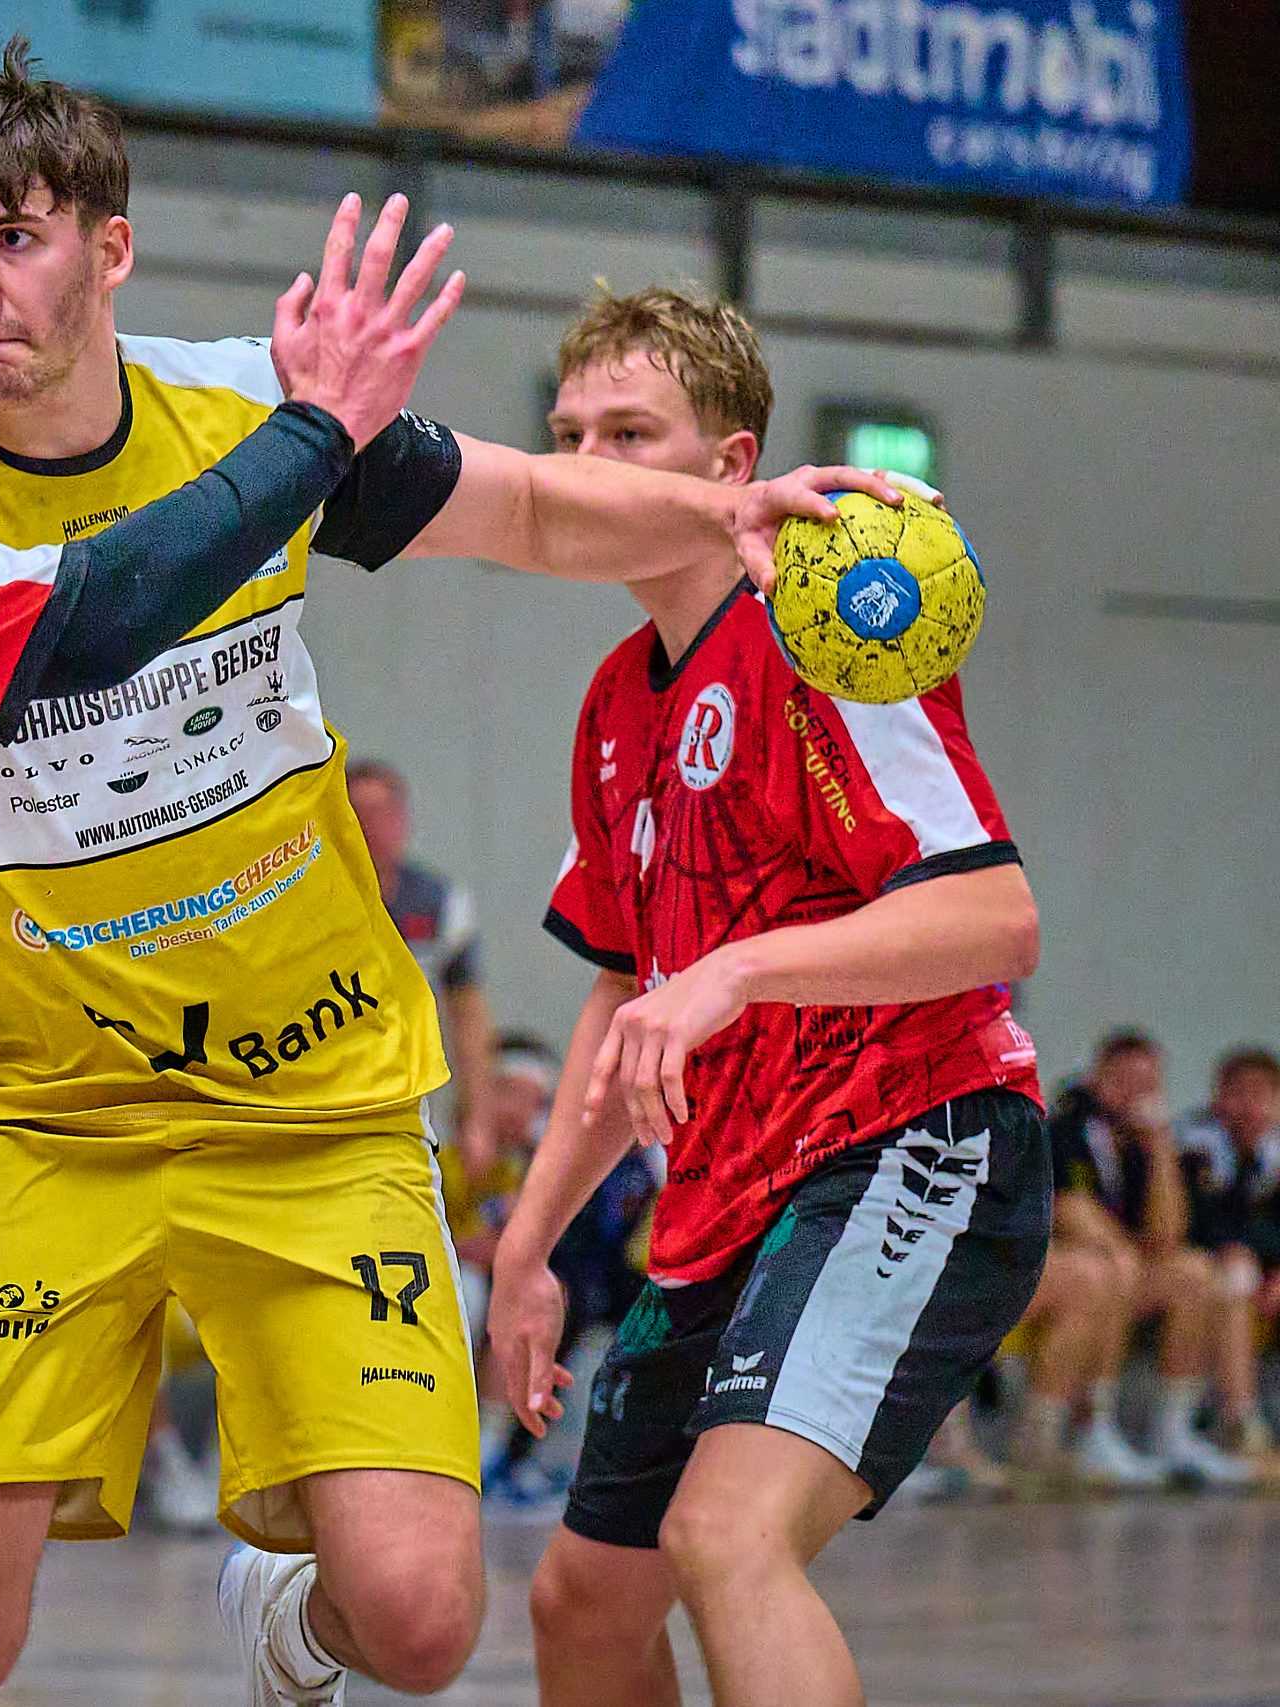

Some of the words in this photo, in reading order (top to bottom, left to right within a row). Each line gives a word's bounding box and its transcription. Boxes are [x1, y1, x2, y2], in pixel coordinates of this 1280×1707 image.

[257, 711, 279, 731] MG
[10, 792, 81, 814] Polestar
[75, 769, 249, 849] WWW.AUTOHAUS-GEISSER.DE
[129, 942, 157, 958] Die
[159, 927, 214, 950] besten
[214, 904, 250, 932] Tarife
[248, 888, 277, 912] zum
[228, 969, 379, 1079] Bank
[351, 1252, 430, 1326] 17
[361, 1366, 435, 1393] HALLENKIND
